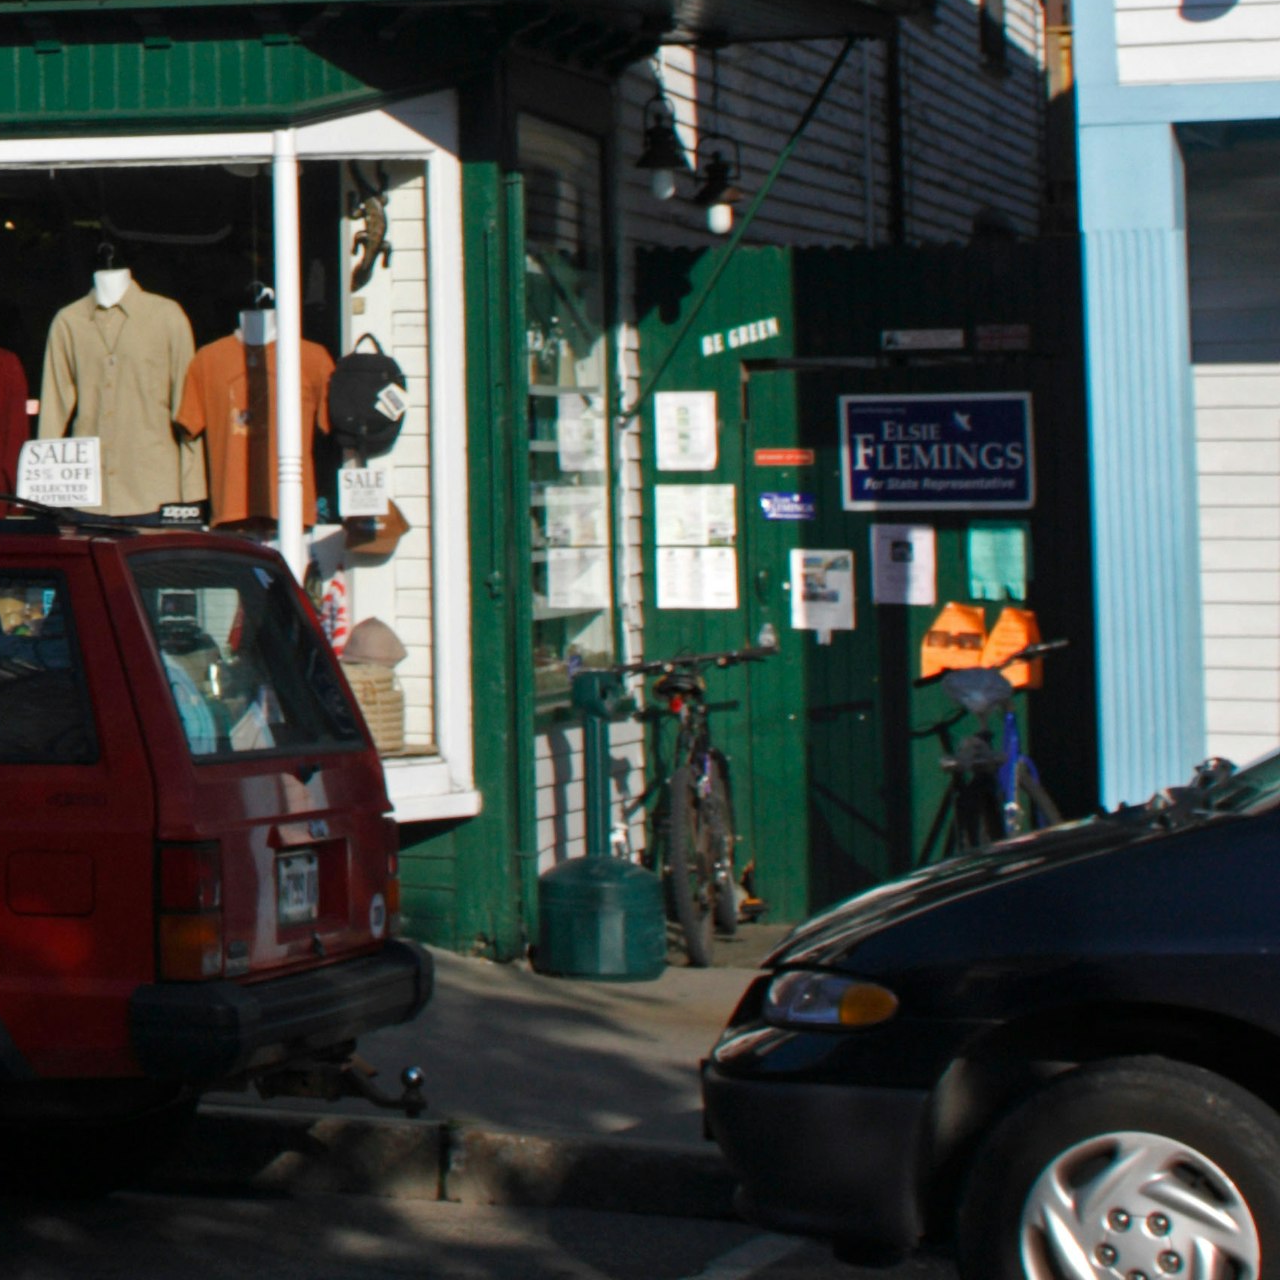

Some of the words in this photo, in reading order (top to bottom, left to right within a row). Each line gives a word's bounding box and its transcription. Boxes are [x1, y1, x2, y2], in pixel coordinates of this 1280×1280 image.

[702, 332, 724, 357] BE
[728, 316, 780, 349] GREEN
[881, 420, 941, 441] ELSIE
[28, 440, 89, 465] SALE
[853, 433, 1025, 471] FLEMINGS
[25, 468, 53, 480] 25%
[60, 467, 93, 480] OFF
[343, 471, 385, 489] SALE
[29, 483, 88, 493] SELECTED
[886, 477, 920, 490] State
[923, 476, 1017, 492] Representative
